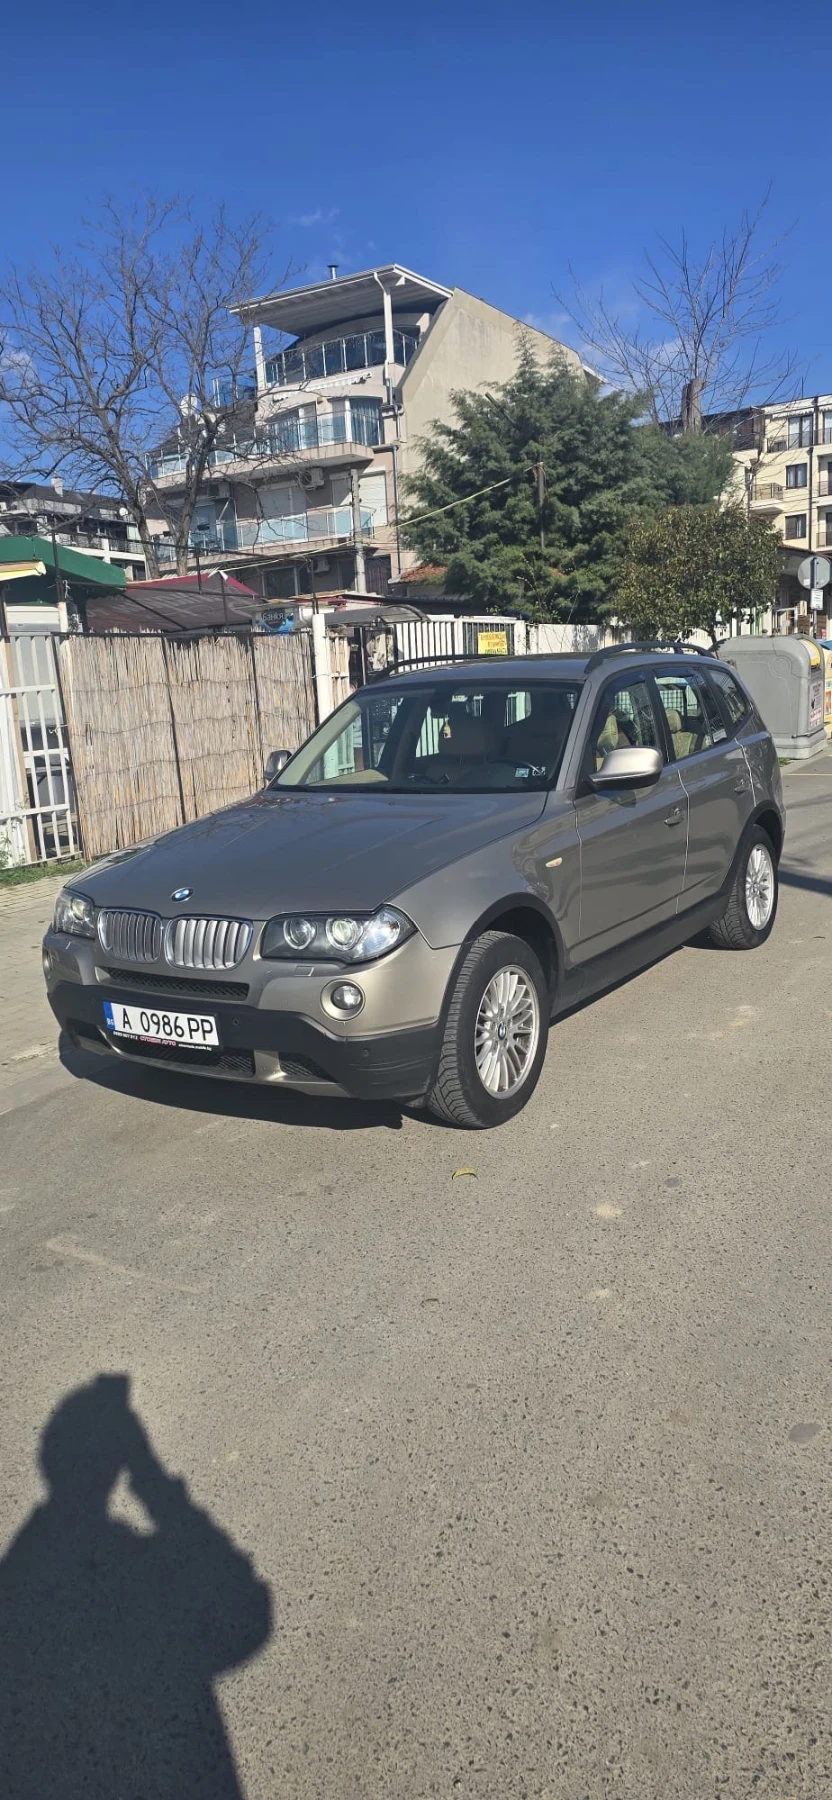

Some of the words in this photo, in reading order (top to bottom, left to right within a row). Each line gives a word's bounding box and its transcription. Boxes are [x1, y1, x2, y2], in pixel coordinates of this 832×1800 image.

[123, 1007, 132, 1030] A
[140, 1011, 185, 1038] 0986
[187, 1017, 213, 1041] PP
